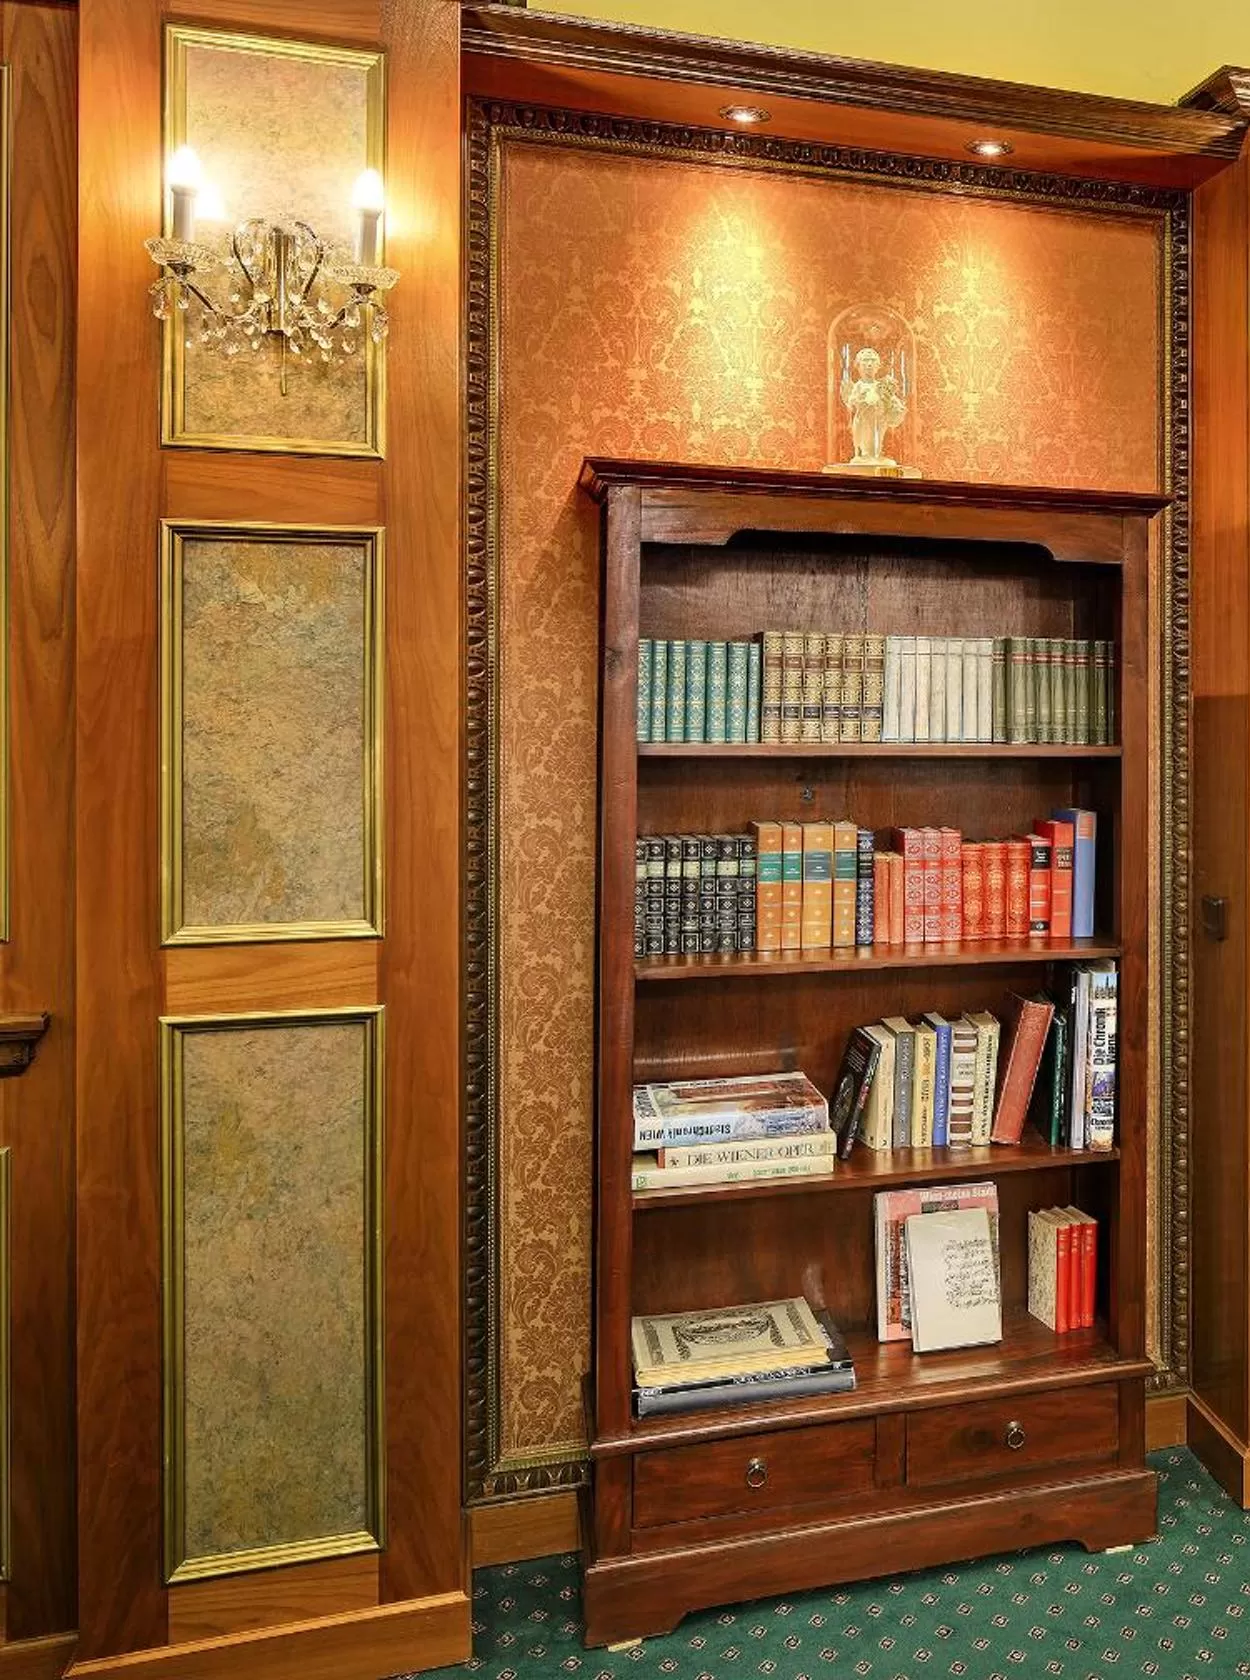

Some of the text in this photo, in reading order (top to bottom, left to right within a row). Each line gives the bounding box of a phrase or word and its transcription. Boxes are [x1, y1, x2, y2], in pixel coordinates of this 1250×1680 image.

[639, 1129, 666, 1141] WIEN
[687, 1144, 815, 1166] DIE WIENER OPER
